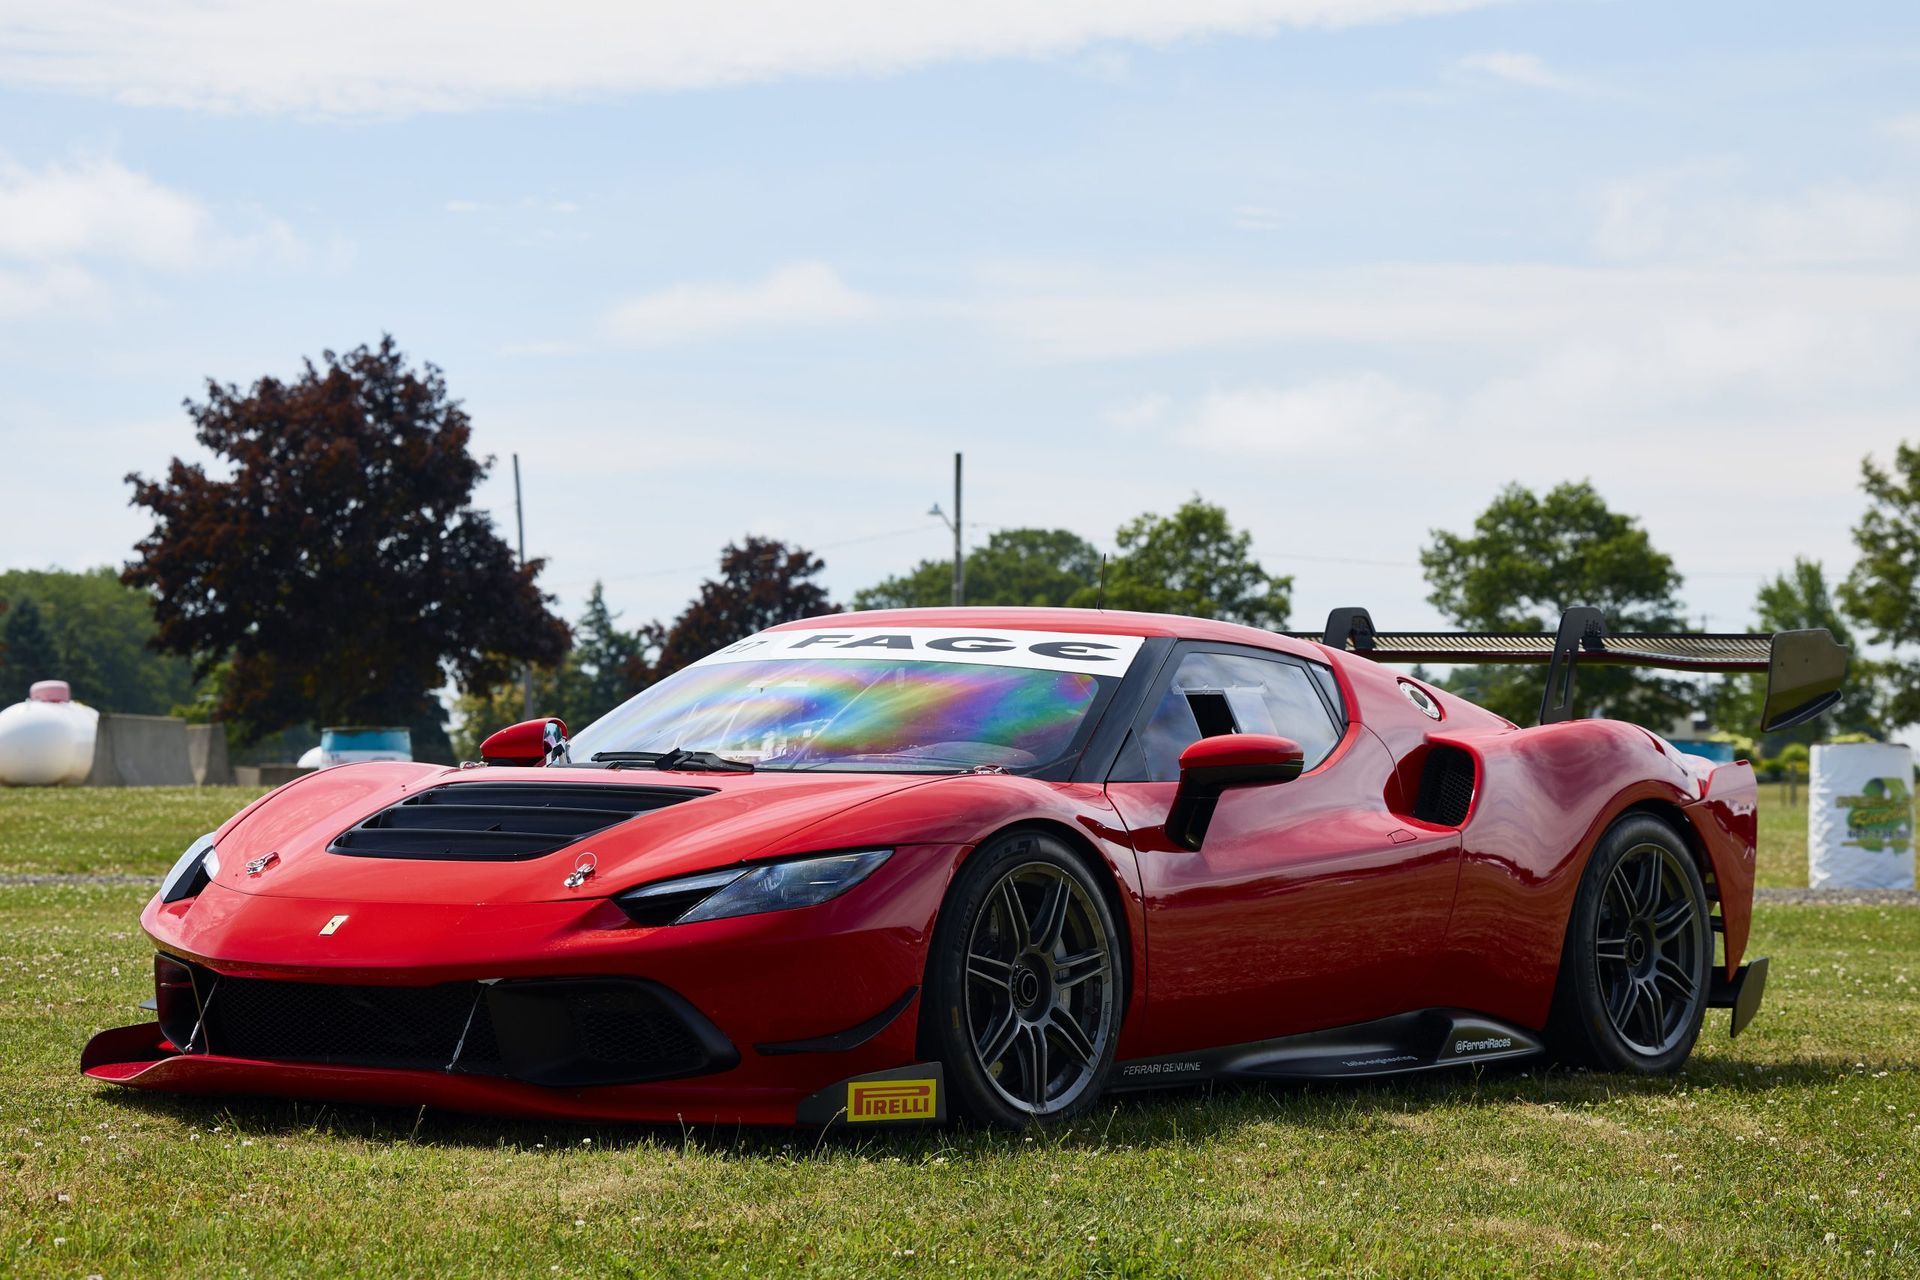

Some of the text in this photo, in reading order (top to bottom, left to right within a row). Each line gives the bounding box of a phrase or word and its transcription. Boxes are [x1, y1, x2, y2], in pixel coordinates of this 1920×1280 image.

[1454, 1037, 1512, 1054] @FerrariRaces
[1123, 1061, 1202, 1076] FERRARI GENUINE
[854, 1085, 931, 1115] PIRELLI
